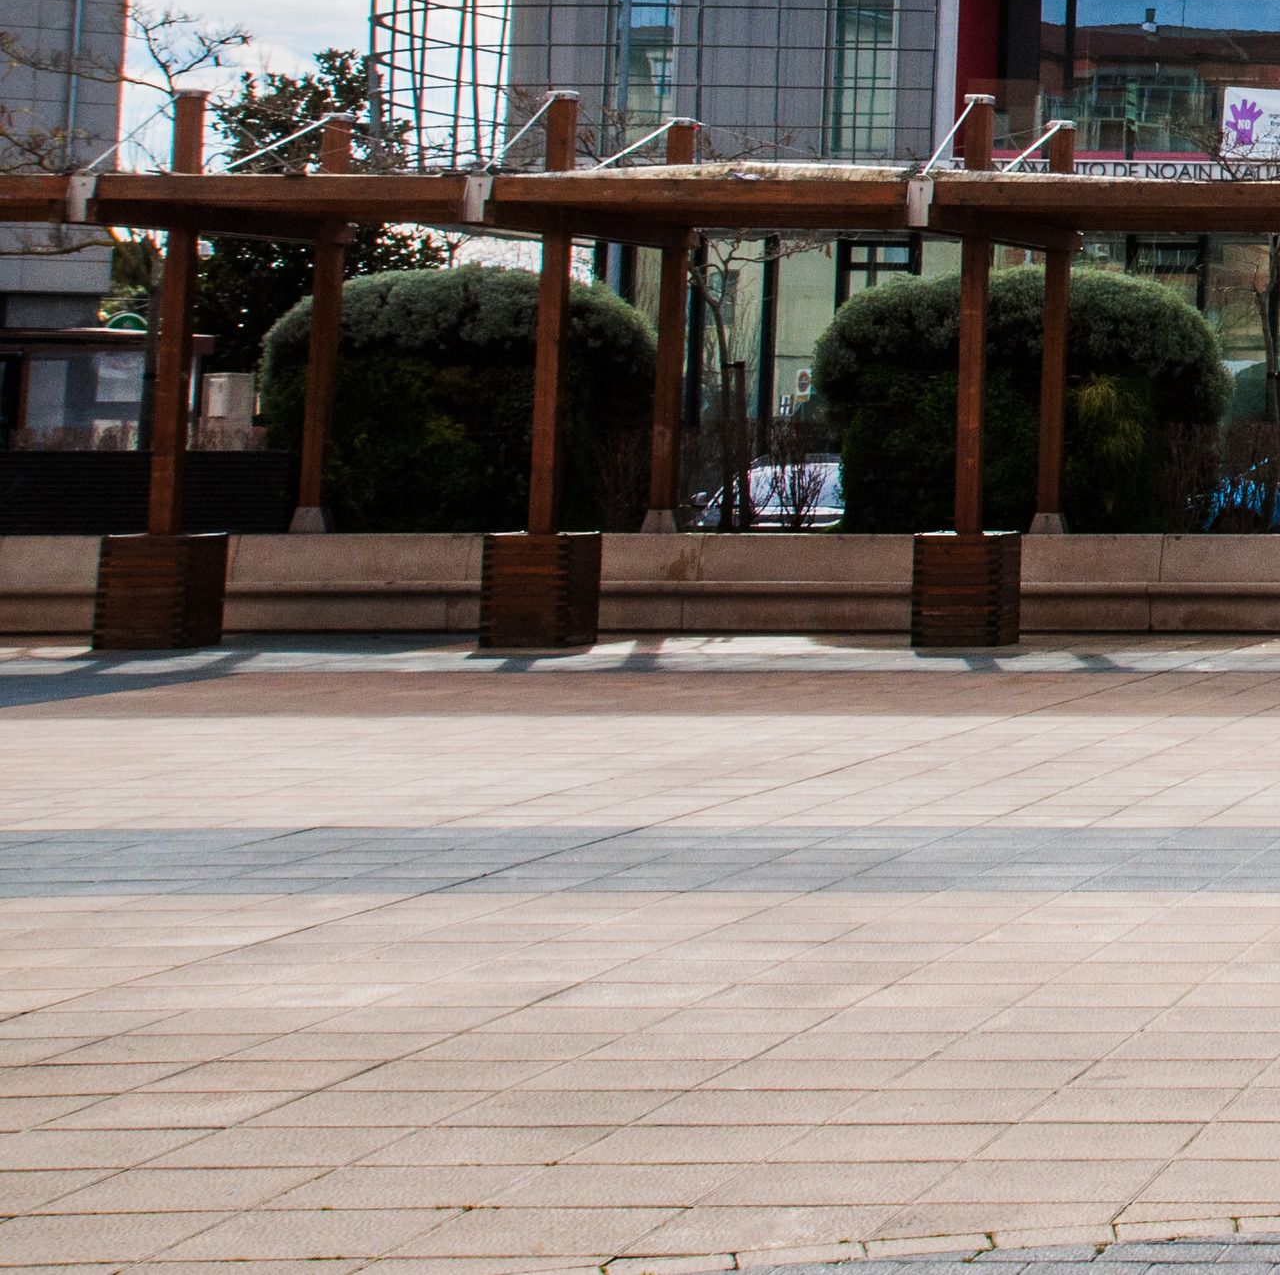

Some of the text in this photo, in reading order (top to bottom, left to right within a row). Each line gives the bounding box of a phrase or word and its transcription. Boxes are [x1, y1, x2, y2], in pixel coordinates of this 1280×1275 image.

[1237, 119, 1251, 130] NO
[1114, 162, 1138, 177] DE
[1145, 163, 1212, 180] NOAIN
